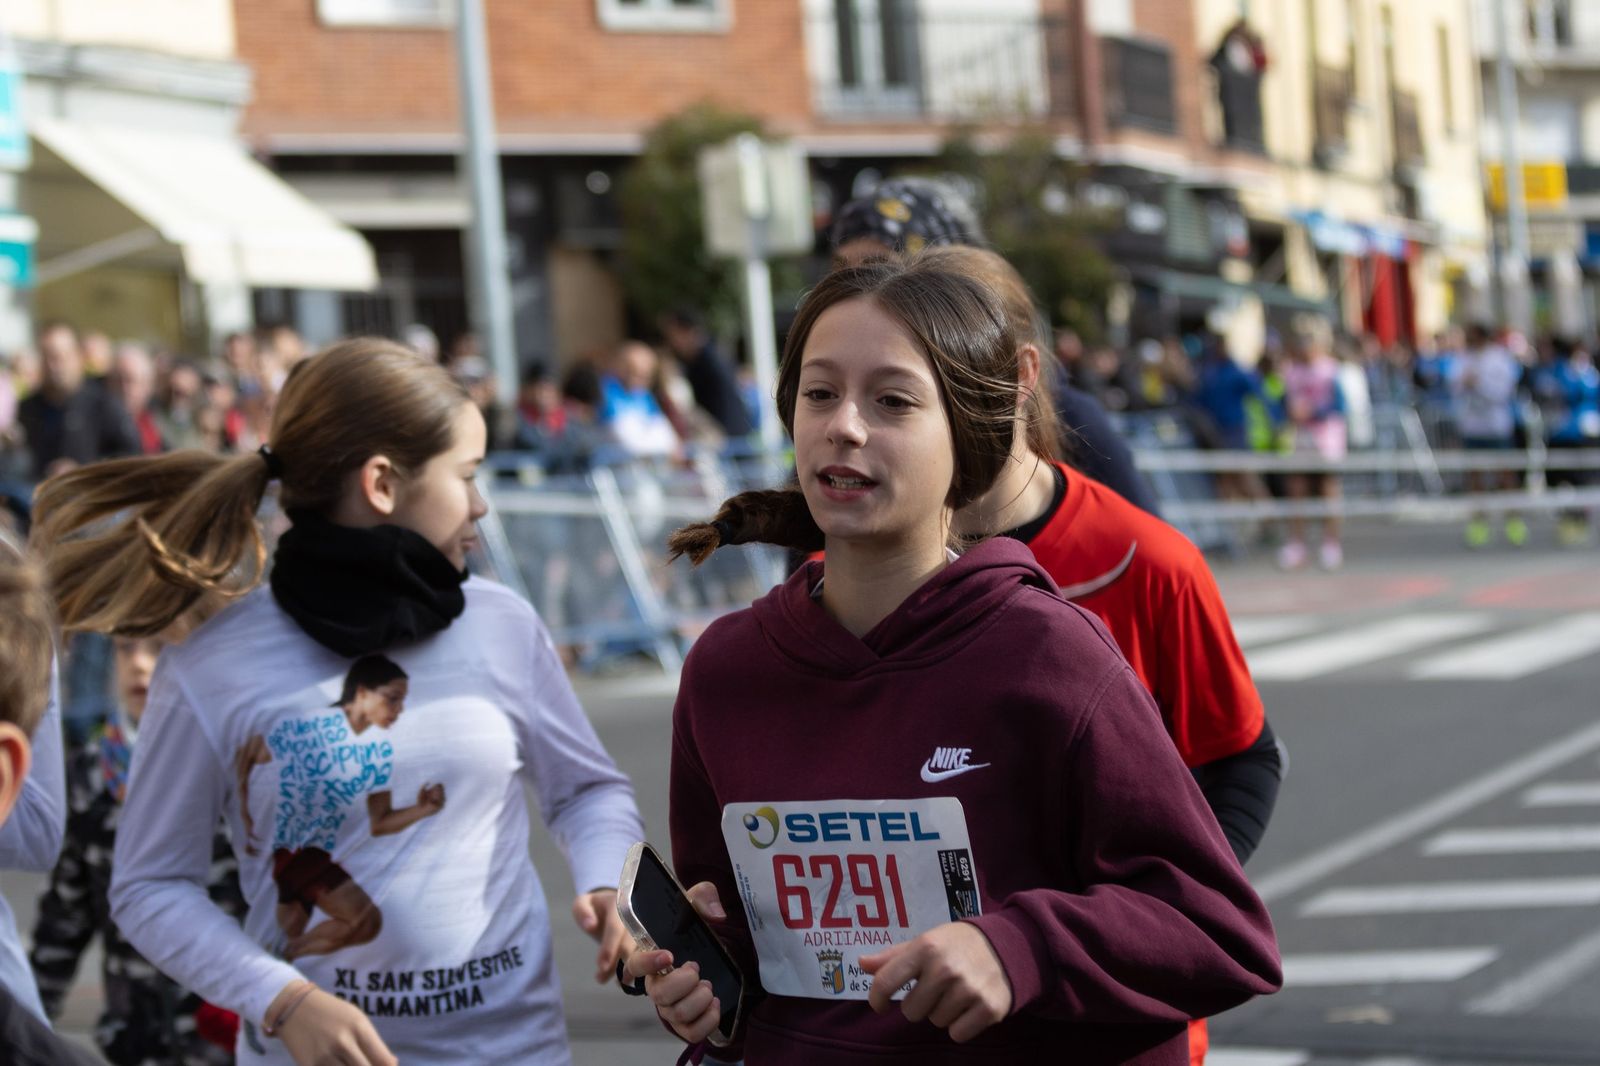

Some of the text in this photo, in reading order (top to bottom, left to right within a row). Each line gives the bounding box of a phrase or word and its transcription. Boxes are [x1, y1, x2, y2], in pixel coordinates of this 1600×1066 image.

[930, 747, 972, 769] NIKE
[785, 811, 940, 843] SETEL
[960, 857, 971, 881] 6291
[773, 854, 909, 929] 6291
[804, 930, 893, 946] ADRIIANAA
[334, 968, 360, 990] XL
[367, 970, 414, 993] SAN
[850, 980, 859, 992] de
